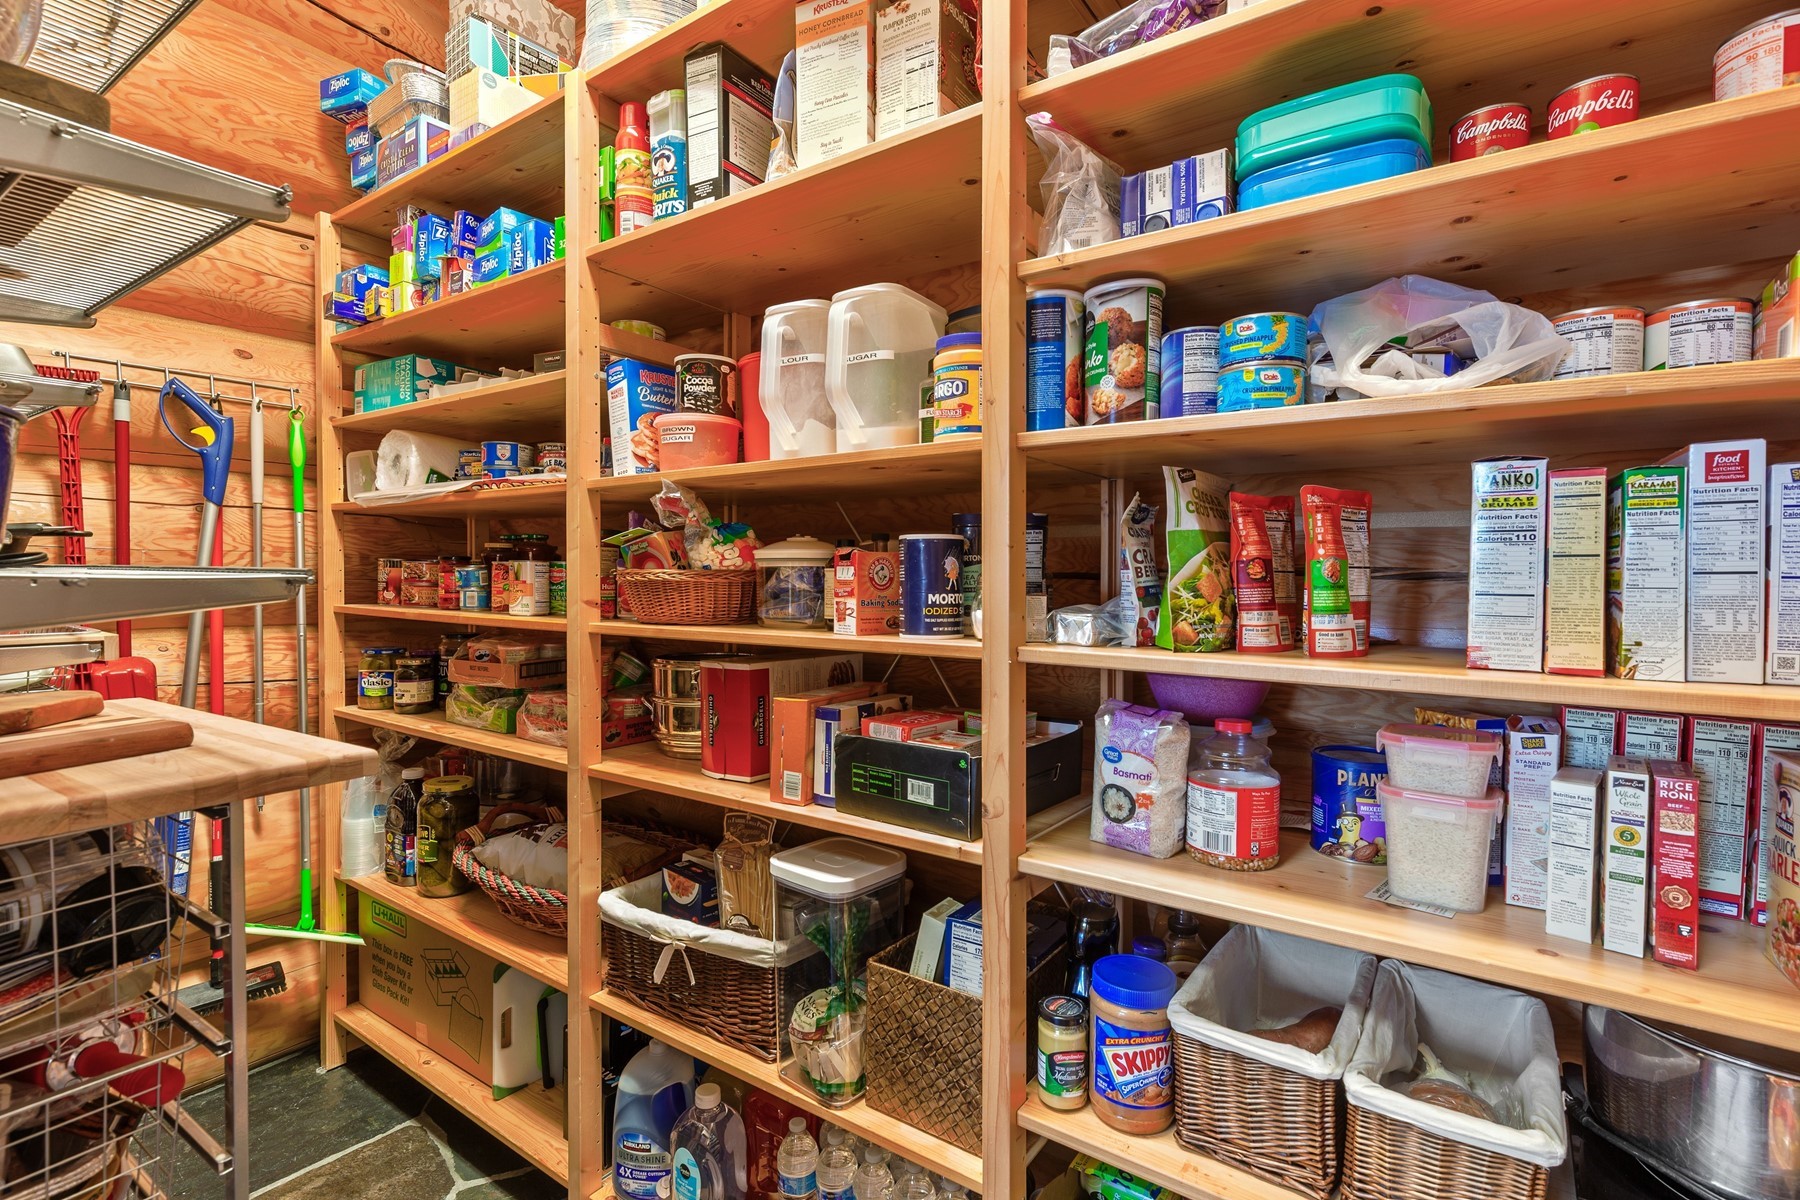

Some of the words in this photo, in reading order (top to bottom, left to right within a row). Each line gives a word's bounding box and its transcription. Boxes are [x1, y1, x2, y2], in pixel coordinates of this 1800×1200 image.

[798, 23, 822, 36] HONEY
[822, 9, 864, 28] CORNBREAD
[882, 17, 904, 32] PUMPKIN
[904, 12, 918, 23] SEED
[1752, 23, 1783, 39] Facts
[1745, 52, 1759, 63] 90
[1762, 44, 1782, 56] 180
[330, 77, 350, 92] Ziploc
[1548, 89, 1634, 133] Campbell's
[1456, 112, 1528, 144] Campbell's
[348, 131, 369, 148] Ziploc
[652, 175, 674, 188] QUAKER
[653, 198, 685, 218] RITS
[482, 220, 495, 238] Ziploc
[418, 232, 427, 262] Ziploc
[513, 232, 522, 269] Ziploc
[480, 258, 499, 274] Ziploc
[1670, 309, 1705, 319] Nutrition
[1708, 307, 1729, 315] Facts
[1555, 319, 1585, 329] Nutrition
[1586, 314, 1607, 323] Facts
[1239, 324, 1254, 333] Dole
[1670, 327, 1693, 336] Calories
[1244, 334, 1274, 345] PINEAPPLE
[781, 355, 809, 364] LOUR
[404, 357, 412, 401] VACUUM
[685, 375, 714, 388] Cocoa
[1263, 373, 1279, 382] Dole
[683, 383, 716, 394] Powder
[661, 426, 694, 434] BROWN
[1713, 453, 1741, 467] food
[1707, 473, 1746, 481] Inspirations
[1692, 487, 1733, 495] Nutrition
[1514, 534, 1537, 542] 110
[860, 600, 885, 608] Baking
[928, 593, 964, 605] MORTO
[922, 606, 959, 615] IODIZED
[1566, 708, 1594, 717] Nutrition
[1627, 715, 1654, 723] Nutrition
[1656, 717, 1678, 725] Facts
[1696, 720, 1728, 729] Nutrition
[1565, 734, 1584, 742] Calories
[1586, 735, 1598, 743] 110
[1601, 736, 1613, 744] 150
[1626, 741, 1646, 749] Calories
[1648, 742, 1661, 750] 110
[1664, 744, 1677, 752] 150
[1532, 749, 1552, 757] Crispy
[1694, 748, 1715, 756] Calories
[1717, 748, 1731, 757] 110
[1734, 750, 1748, 759] 150
[1515, 759, 1552, 767] STANDARD
[1112, 766, 1152, 782] Basmati
[1659, 779, 1694, 792] RICE
[1552, 791, 1577, 800] Nutrition
[1614, 788, 1641, 800] Whole
[1659, 789, 1695, 802] RONI
[1618, 797, 1643, 808] Grain
[1610, 810, 1646, 819] COUSCOUS
[1774, 834, 1797, 860] QUICK
[373, 904, 405, 929] U-HAUL
[953, 922, 972, 933] Nutrition
[371, 937, 382, 951] This
[382, 942, 393, 956] box
[393, 947, 399, 958] is
[399, 950, 414, 967] FREE
[952, 941, 968, 952] Calories
[371, 953, 386, 968] when
[385, 960, 396, 974] you
[396, 964, 407, 980] buy
[371, 965, 383, 979] Dish
[383, 970, 399, 987] Saver
[406, 985, 414, 995] or
[372, 979, 386, 995] Glass
[386, 987, 400, 1000] Pack
[400, 993, 410, 1007] Kit!
[1105, 1036, 1130, 1045] EXTRA
[1130, 1034, 1165, 1045] CRUNCHY
[1111, 1044, 1171, 1077] SKIPPY
[1121, 1080, 1140, 1094] SUPER
[623, 1140, 651, 1150] KIRKLAND
[618, 1153, 640, 1164] ULTRA
[640, 1154, 667, 1165] SHINE
[618, 1165, 633, 1179] 4X
